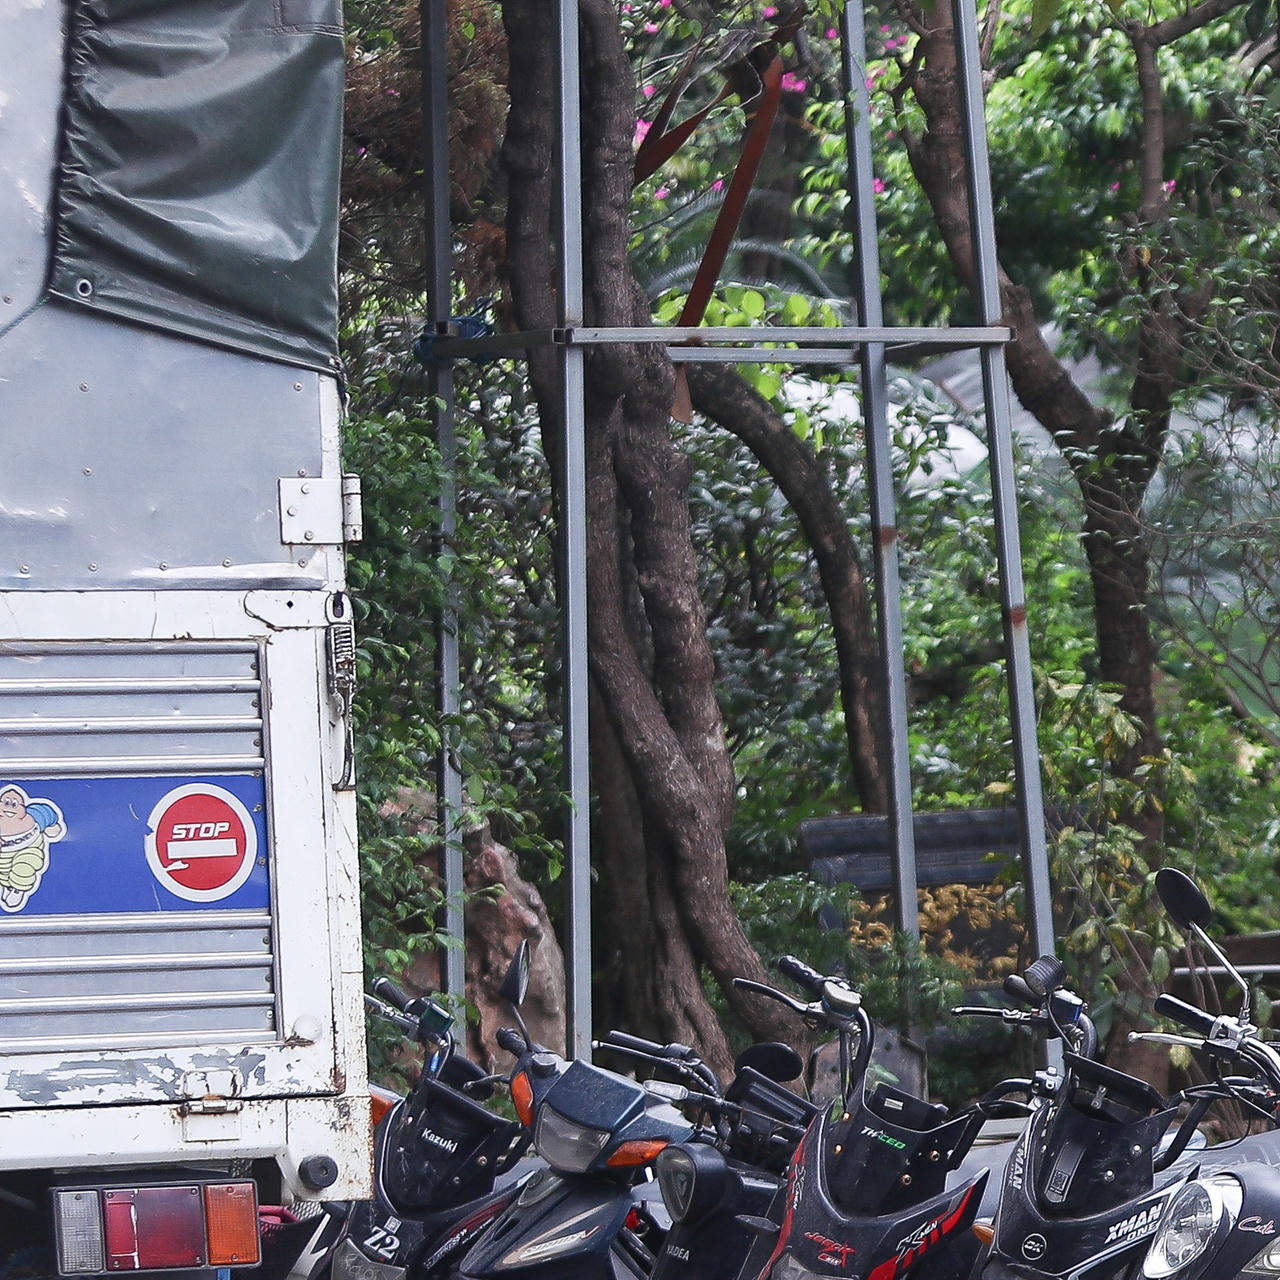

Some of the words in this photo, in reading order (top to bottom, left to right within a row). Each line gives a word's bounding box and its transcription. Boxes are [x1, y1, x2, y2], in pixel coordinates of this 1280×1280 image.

[172, 821, 231, 840] STOP
[422, 1127, 459, 1153] Kazuki
[1105, 1202, 1164, 1244] XMAN
[364, 1226, 400, 1259] Z2
